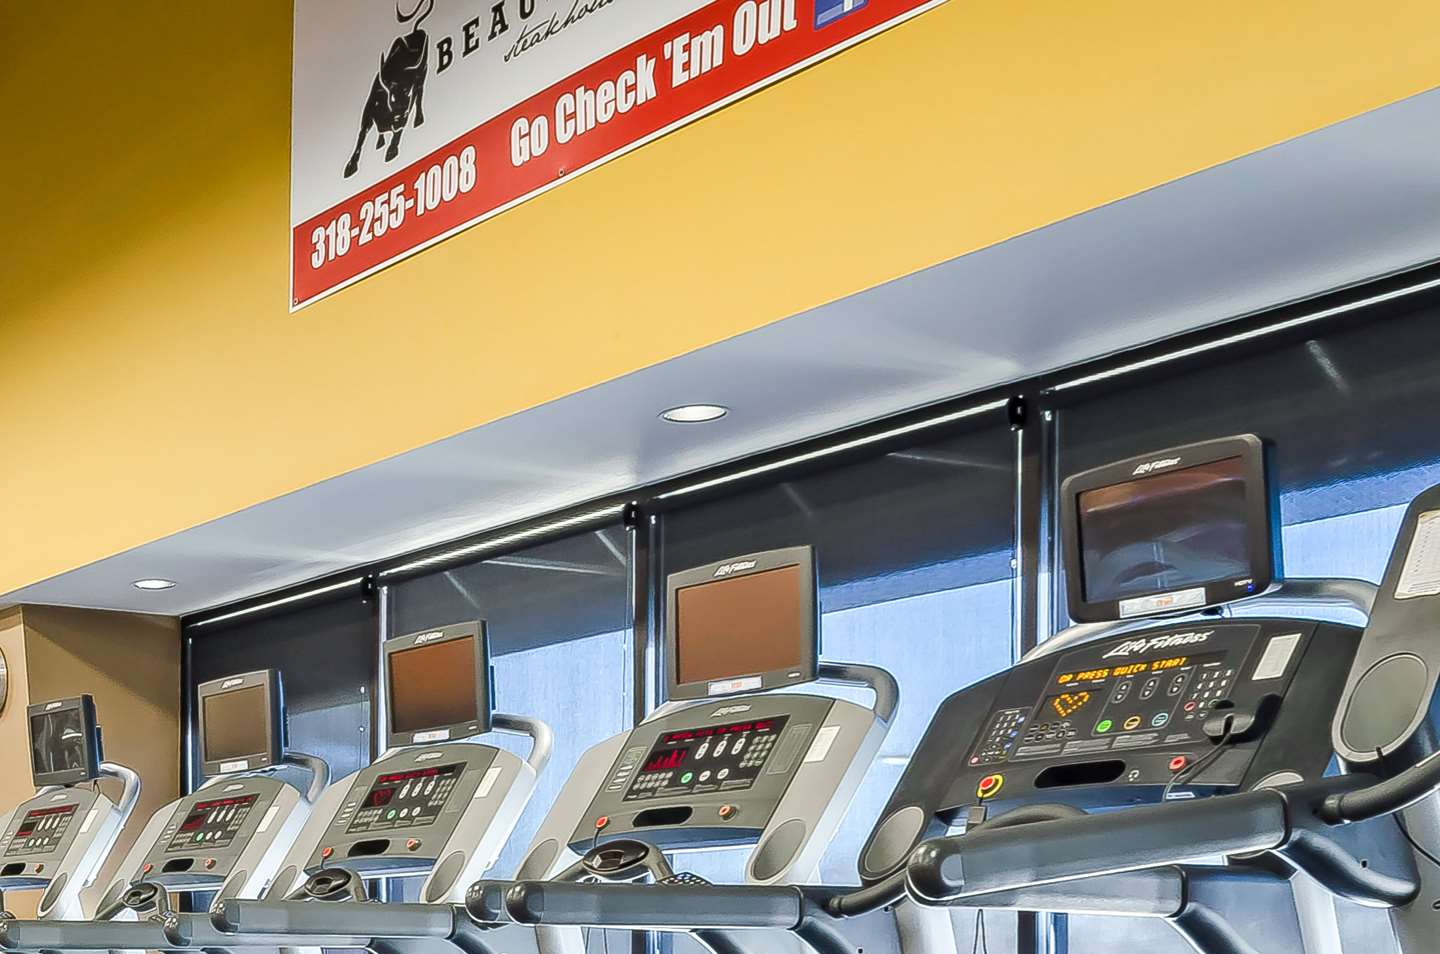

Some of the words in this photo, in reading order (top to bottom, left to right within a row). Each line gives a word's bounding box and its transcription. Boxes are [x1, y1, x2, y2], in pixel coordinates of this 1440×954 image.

[311, 145, 477, 269] 318-255-1008
[510, 116, 549, 167] Go
[555, 53, 657, 144] Check
[663, 24, 725, 88] 'Em
[732, 0, 798, 56] Out
